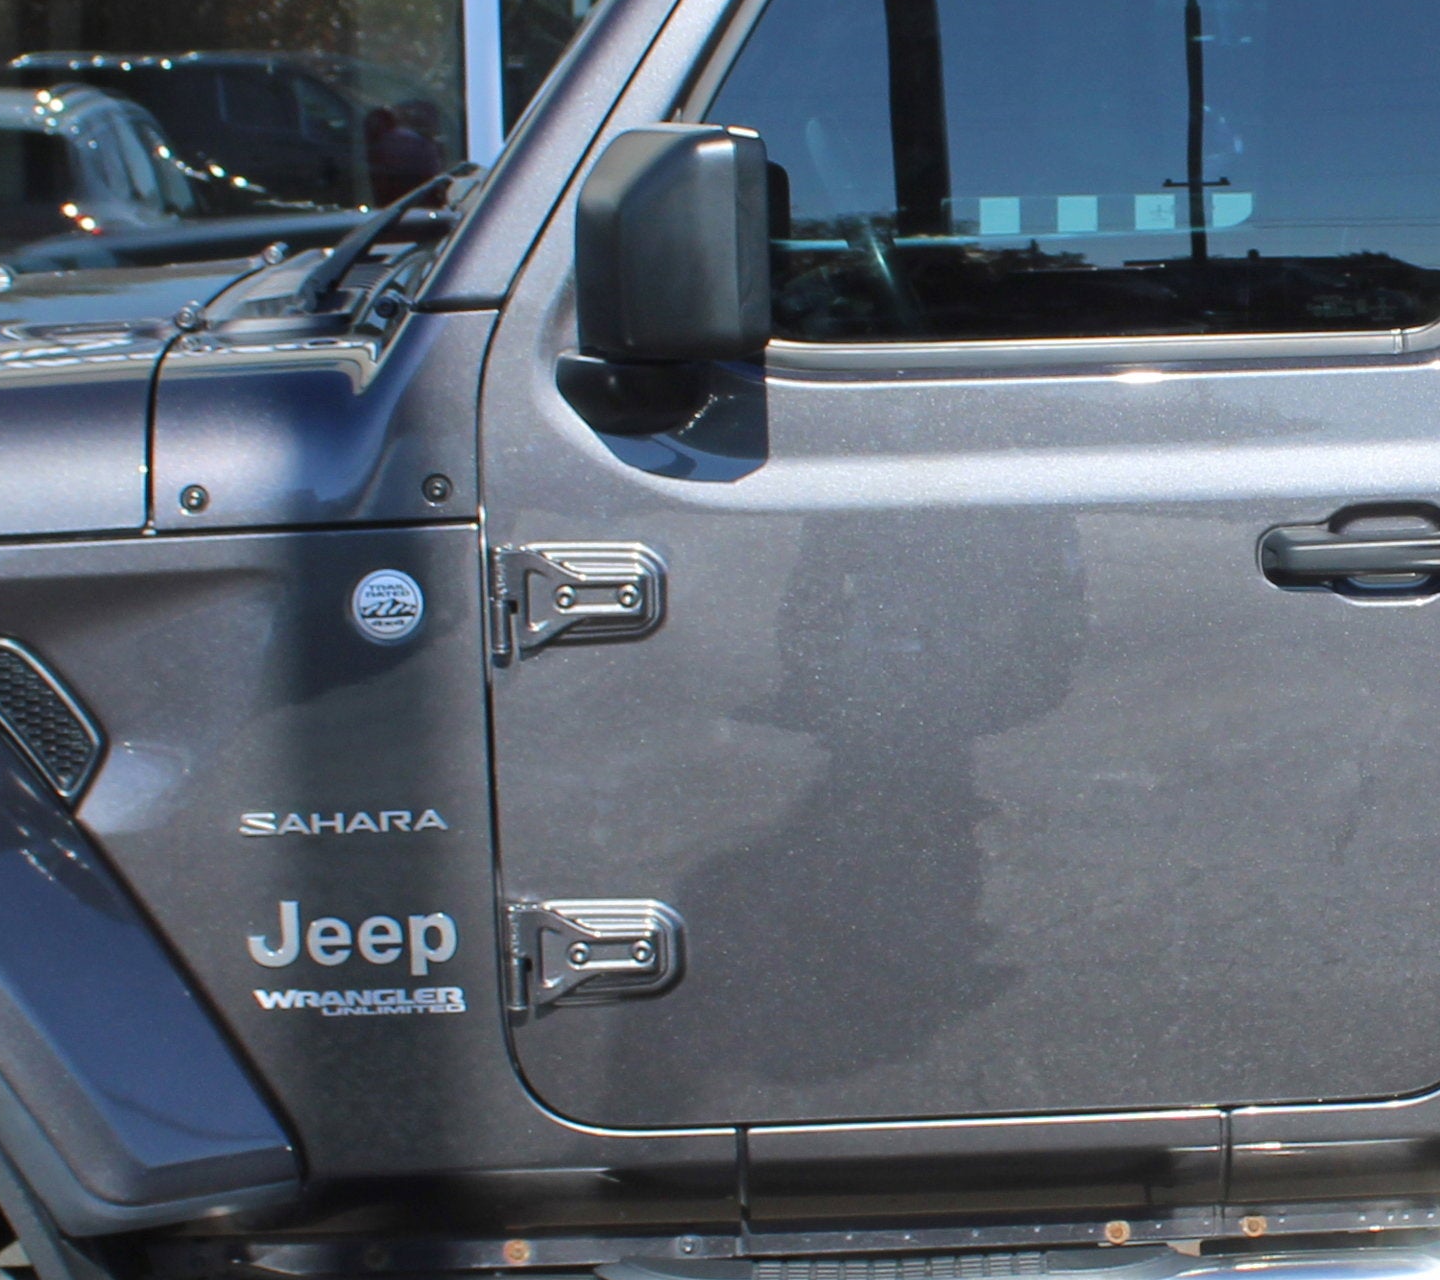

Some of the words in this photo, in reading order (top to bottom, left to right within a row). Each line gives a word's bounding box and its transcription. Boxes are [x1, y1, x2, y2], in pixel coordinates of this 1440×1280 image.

[238, 808, 449, 837] SAHARA
[246, 899, 458, 977] Jeep
[252, 986, 465, 1010] WRANGLER
[321, 1004, 467, 1017] UNLIMITED
